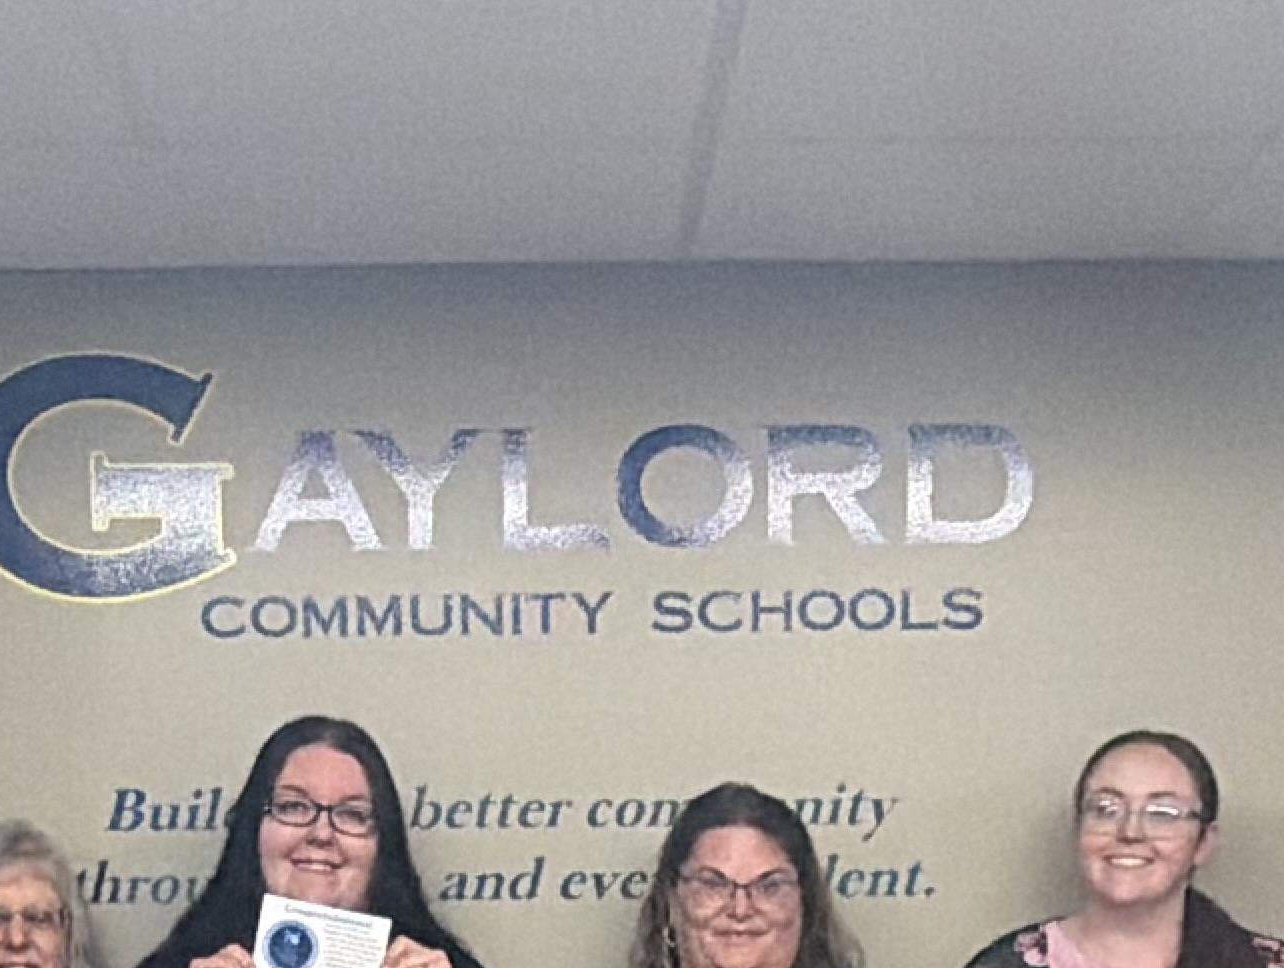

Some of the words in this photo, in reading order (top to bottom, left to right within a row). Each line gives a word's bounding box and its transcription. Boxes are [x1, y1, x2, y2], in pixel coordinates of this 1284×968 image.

[201, 590, 613, 638] COMMUNITY
[652, 587, 984, 636] SCHOOLS
[410, 784, 573, 830] better
[440, 856, 545, 901] and
